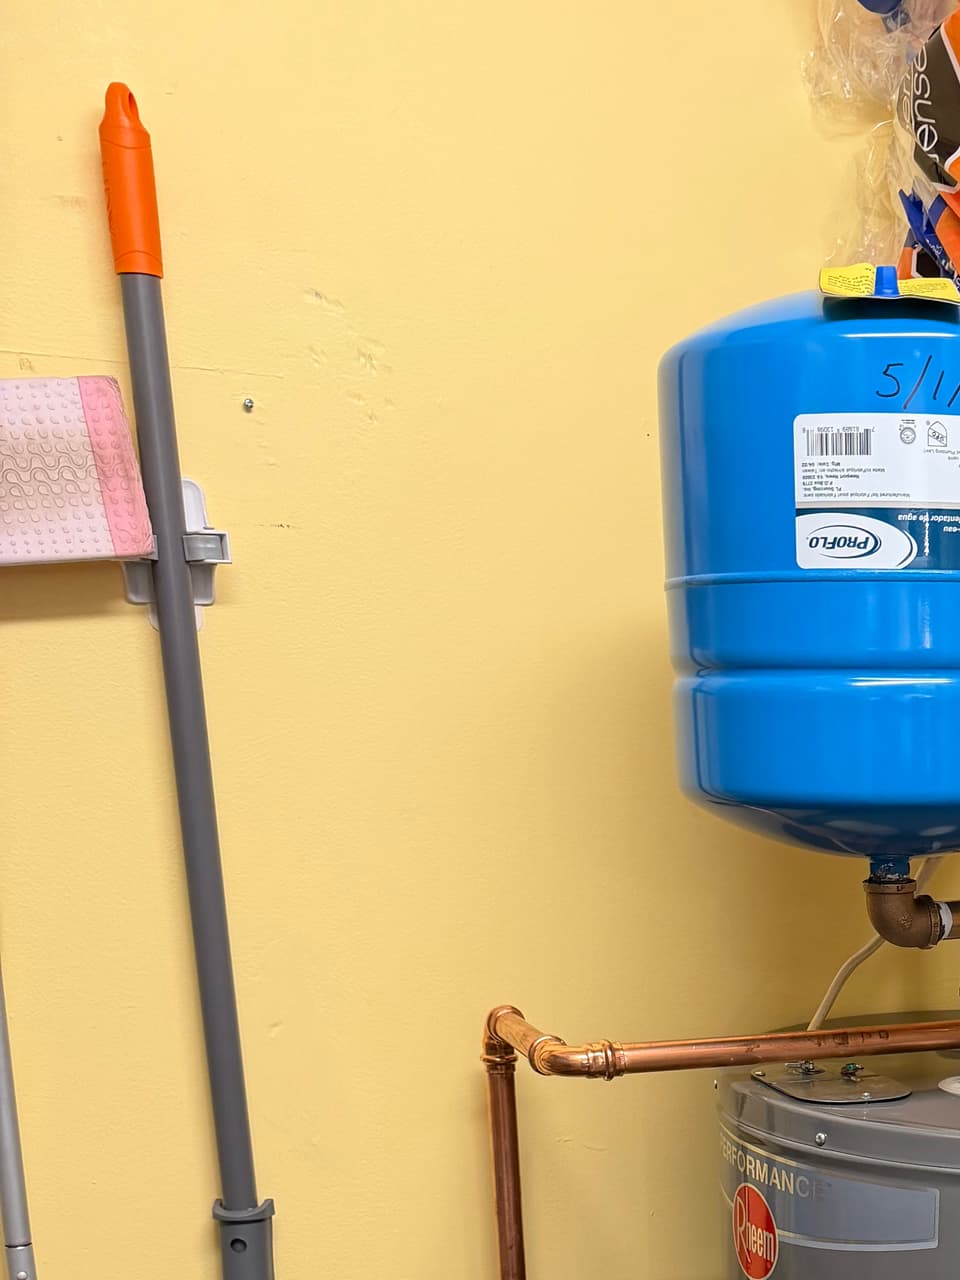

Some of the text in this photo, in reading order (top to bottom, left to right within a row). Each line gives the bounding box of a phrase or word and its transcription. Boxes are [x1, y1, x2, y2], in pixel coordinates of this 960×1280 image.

[897, 513, 918, 521] agua
[808, 536, 870, 550] PROFLO
[736, 1186, 775, 1264] Rheem
